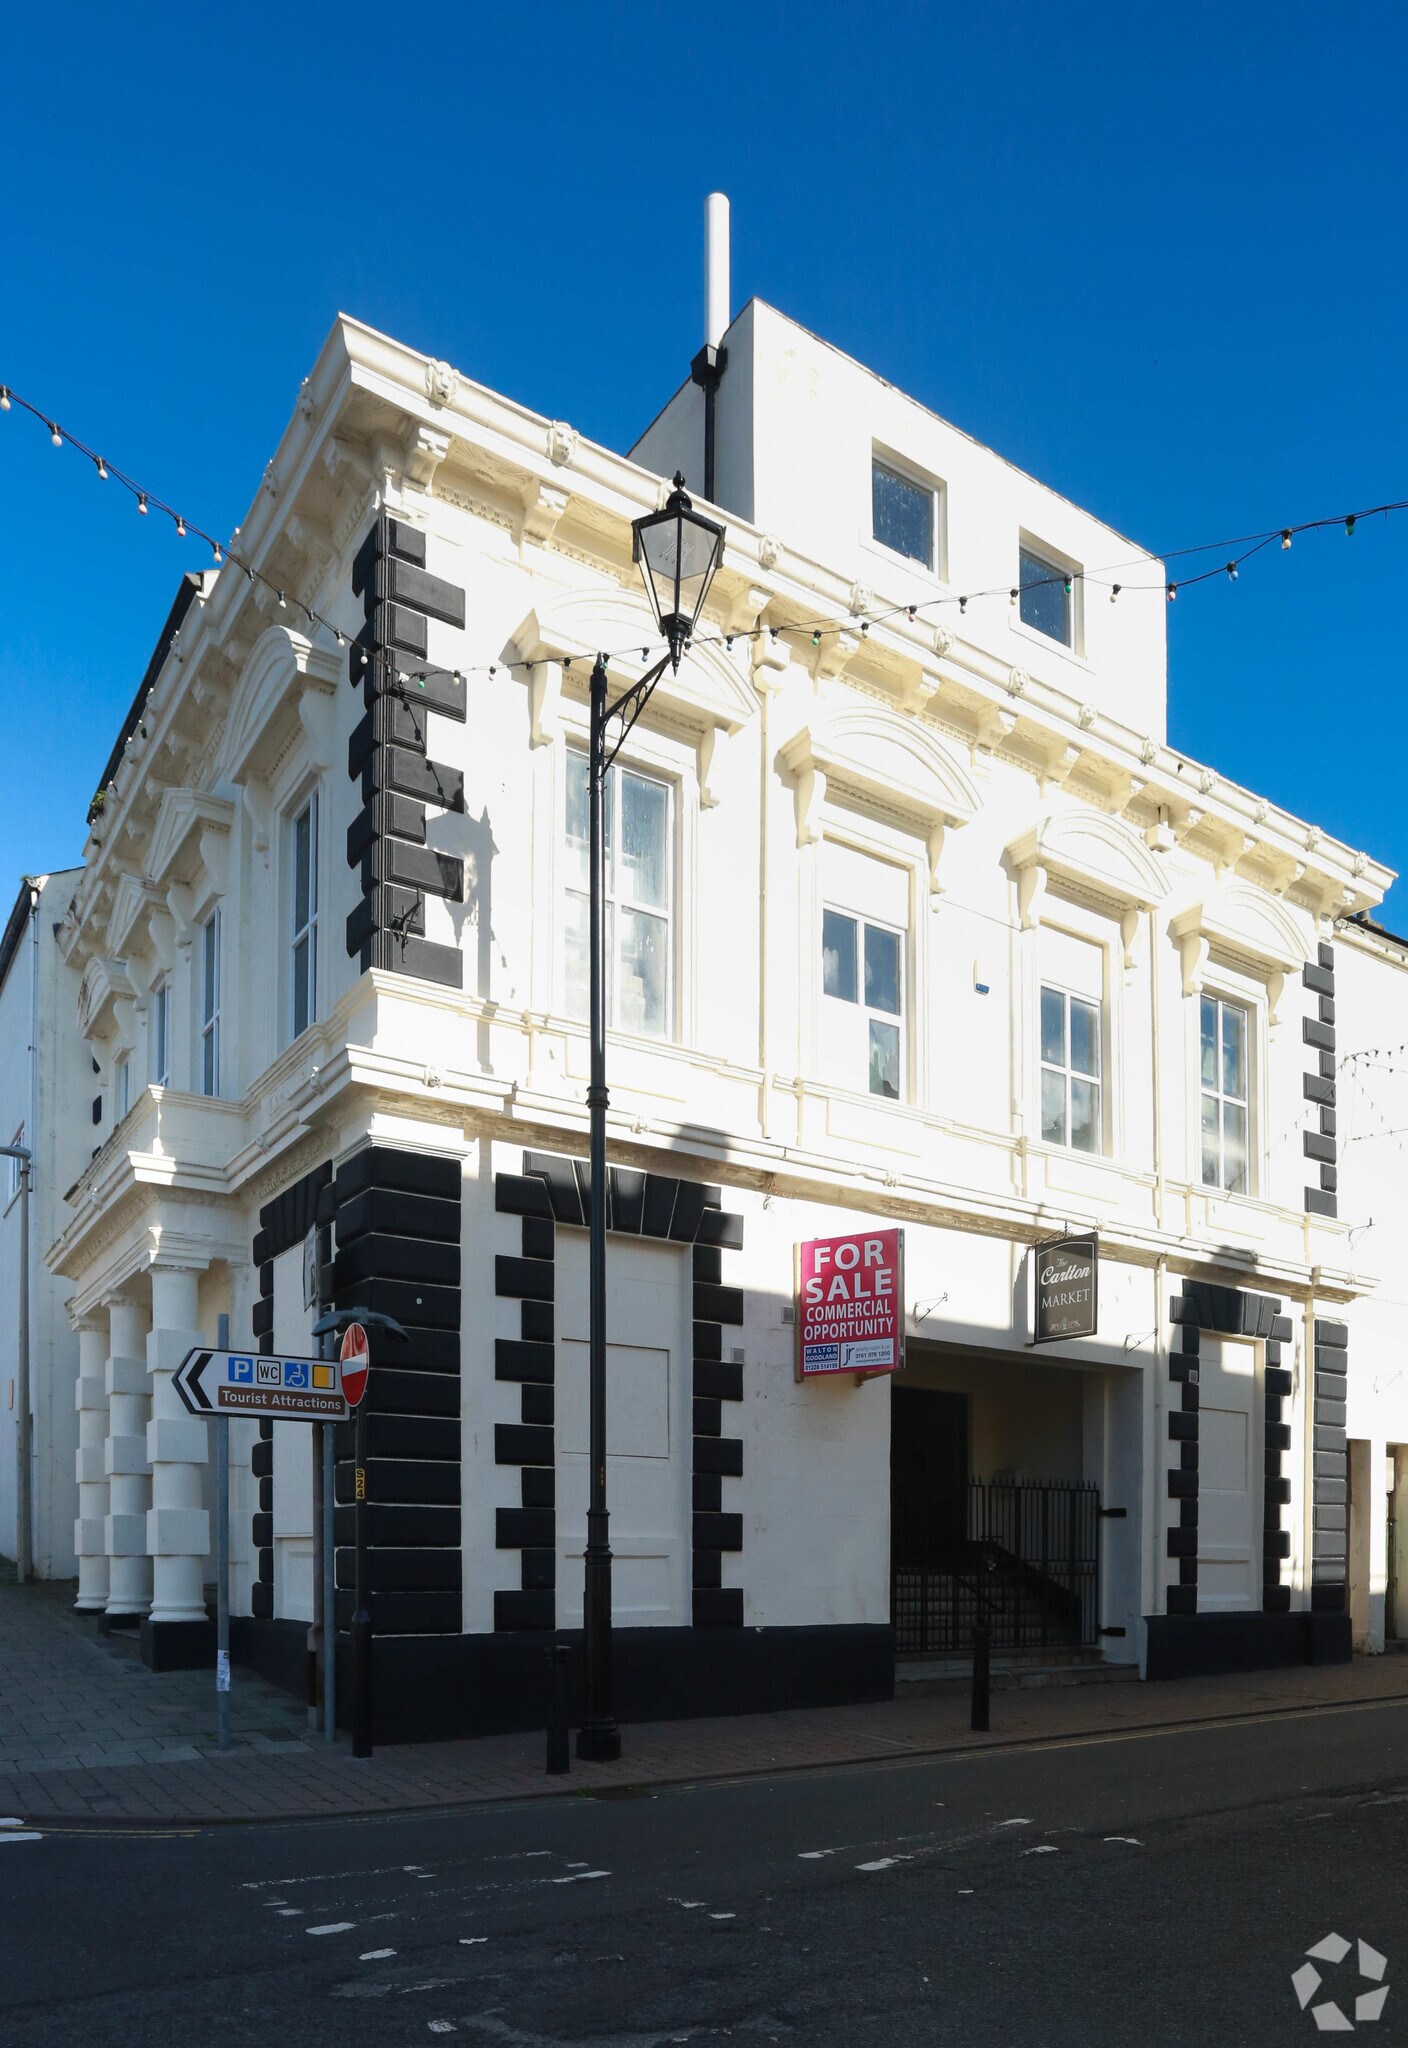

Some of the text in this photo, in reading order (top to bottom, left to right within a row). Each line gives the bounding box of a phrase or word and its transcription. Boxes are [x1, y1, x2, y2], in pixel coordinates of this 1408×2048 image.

[814, 1239, 884, 1273] FOR
[1056, 1258, 1068, 1267] The
[1041, 1264, 1091, 1285] Carlton
[805, 1268, 892, 1304] SALE
[1041, 1288, 1091, 1309] MARKET
[806, 1299, 891, 1322] COMMERCIAL
[804, 1317, 894, 1341] OPPORTUNITY
[806, 1346, 838, 1354] WALTON
[806, 1353, 838, 1362] GOODLAND
[234, 1360, 278, 1380] P WC
[222, 1390, 341, 1410] Tourist Attractions
